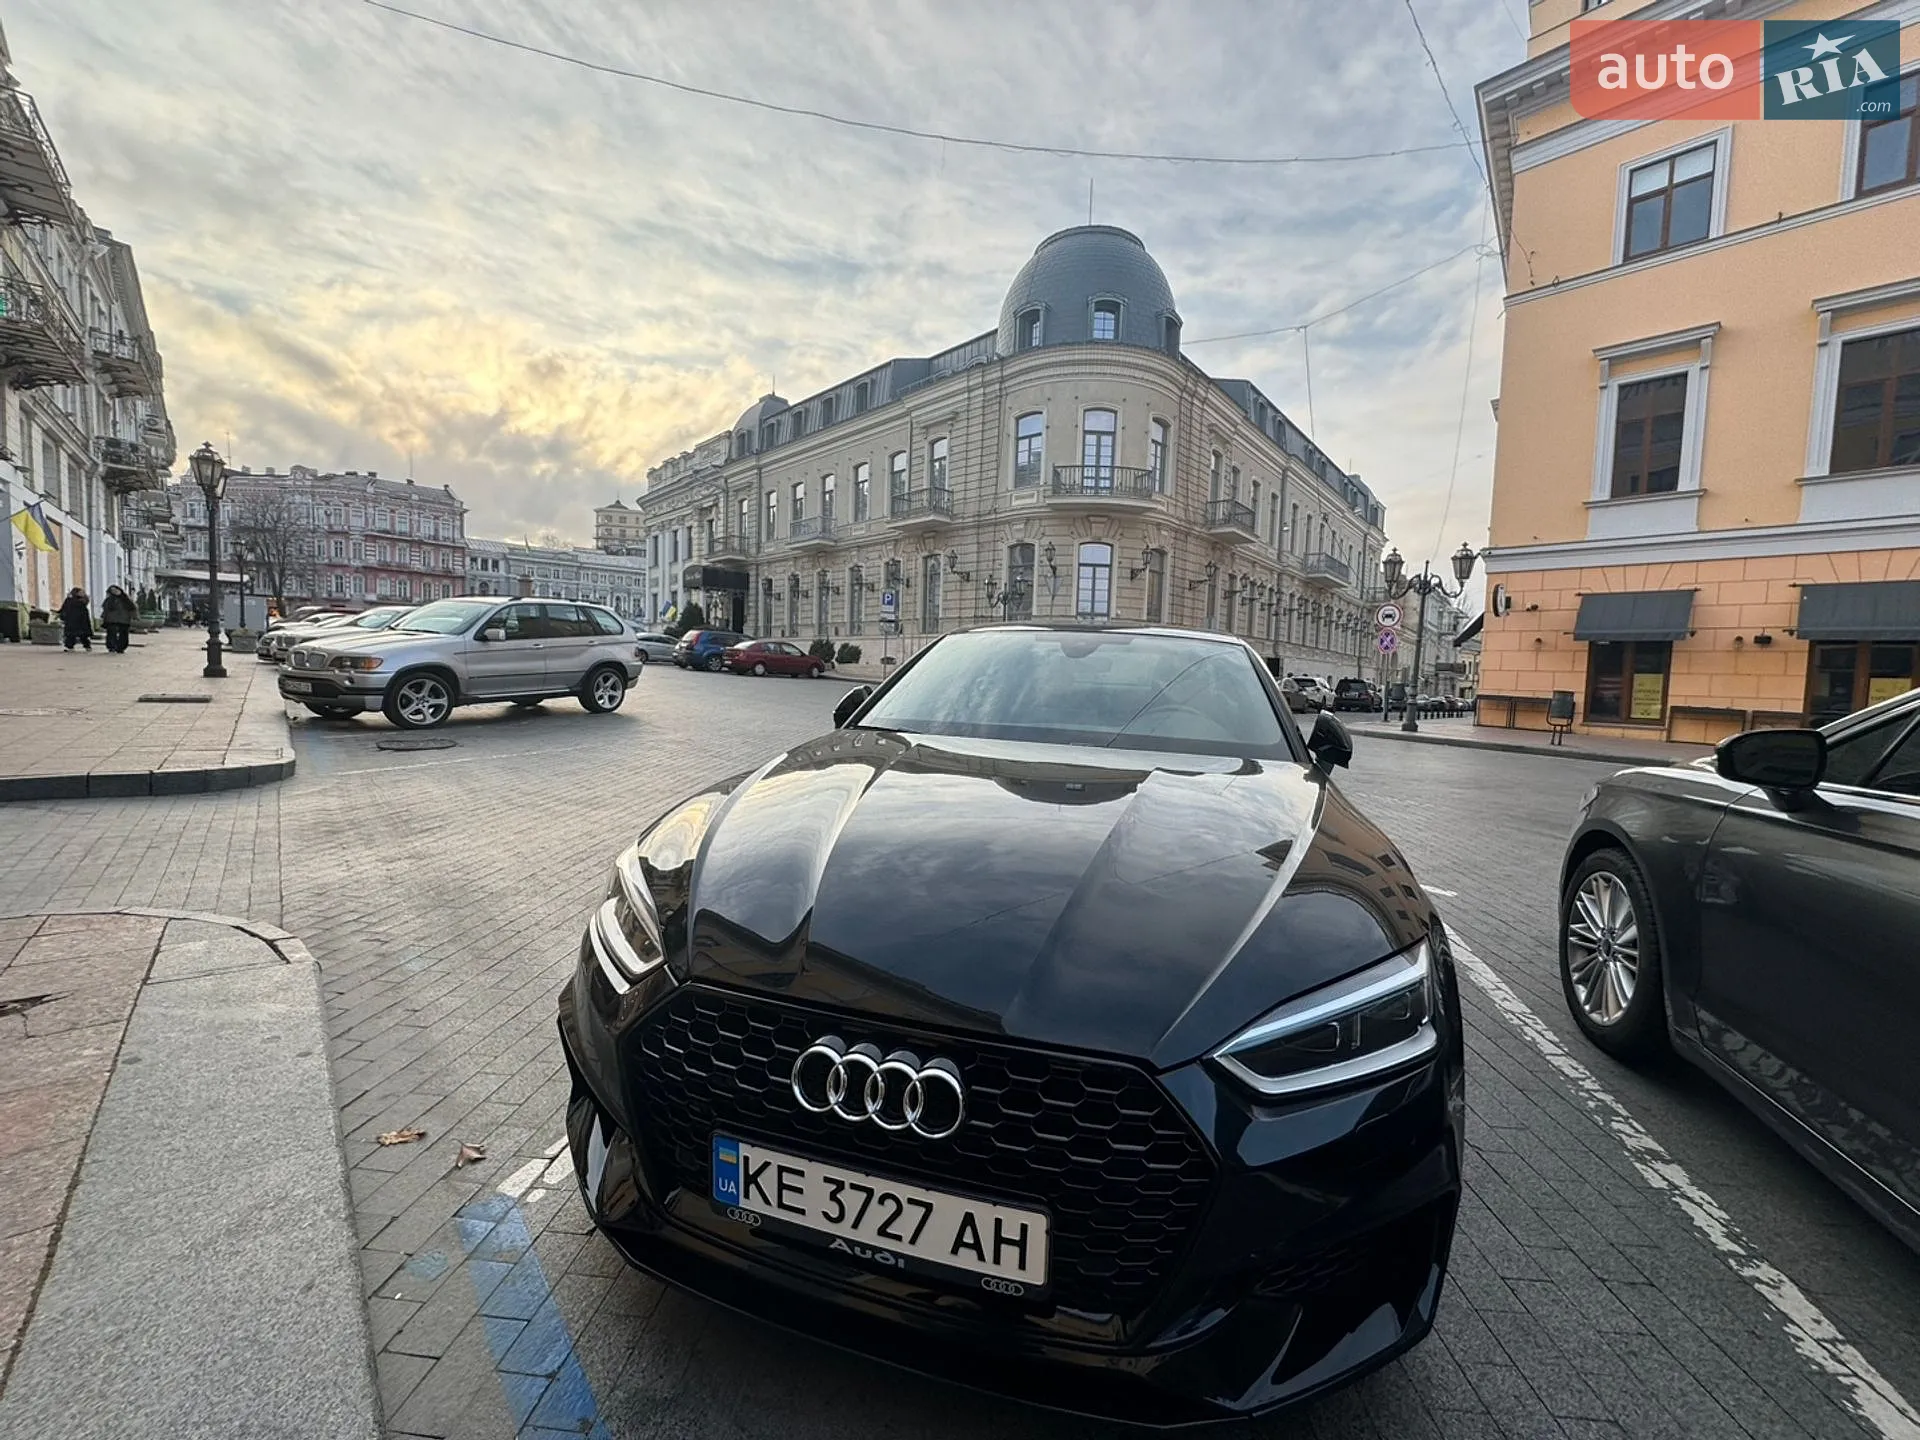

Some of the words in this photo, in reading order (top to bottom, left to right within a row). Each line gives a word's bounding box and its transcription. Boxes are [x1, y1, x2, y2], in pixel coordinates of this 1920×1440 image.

[884, 593, 892, 605] P
[718, 1177, 737, 1195] UA
[742, 1154, 807, 1216] KE
[821, 1175, 934, 1246] 3727
[950, 1211, 1029, 1271] AH
[828, 1237, 906, 1268] Audi
